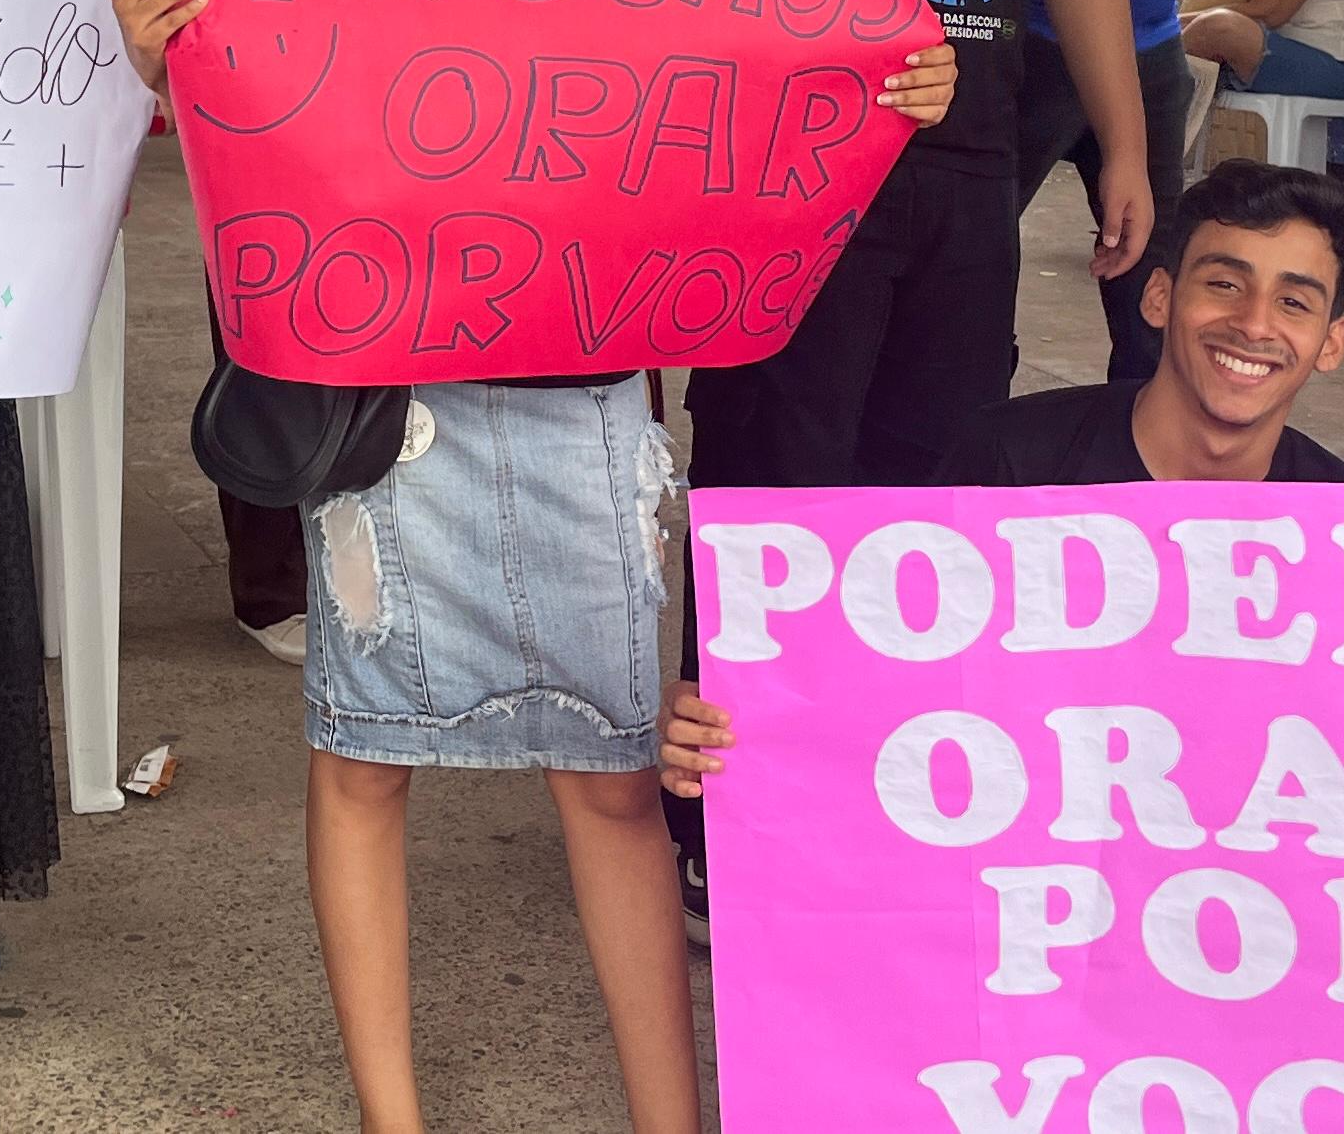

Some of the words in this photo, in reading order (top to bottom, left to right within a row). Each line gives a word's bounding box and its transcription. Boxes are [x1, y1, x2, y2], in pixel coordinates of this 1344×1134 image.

[943, 13, 964, 26] DAS
[384, 47, 868, 201] ORAR
[214, 211, 542, 355] POR
